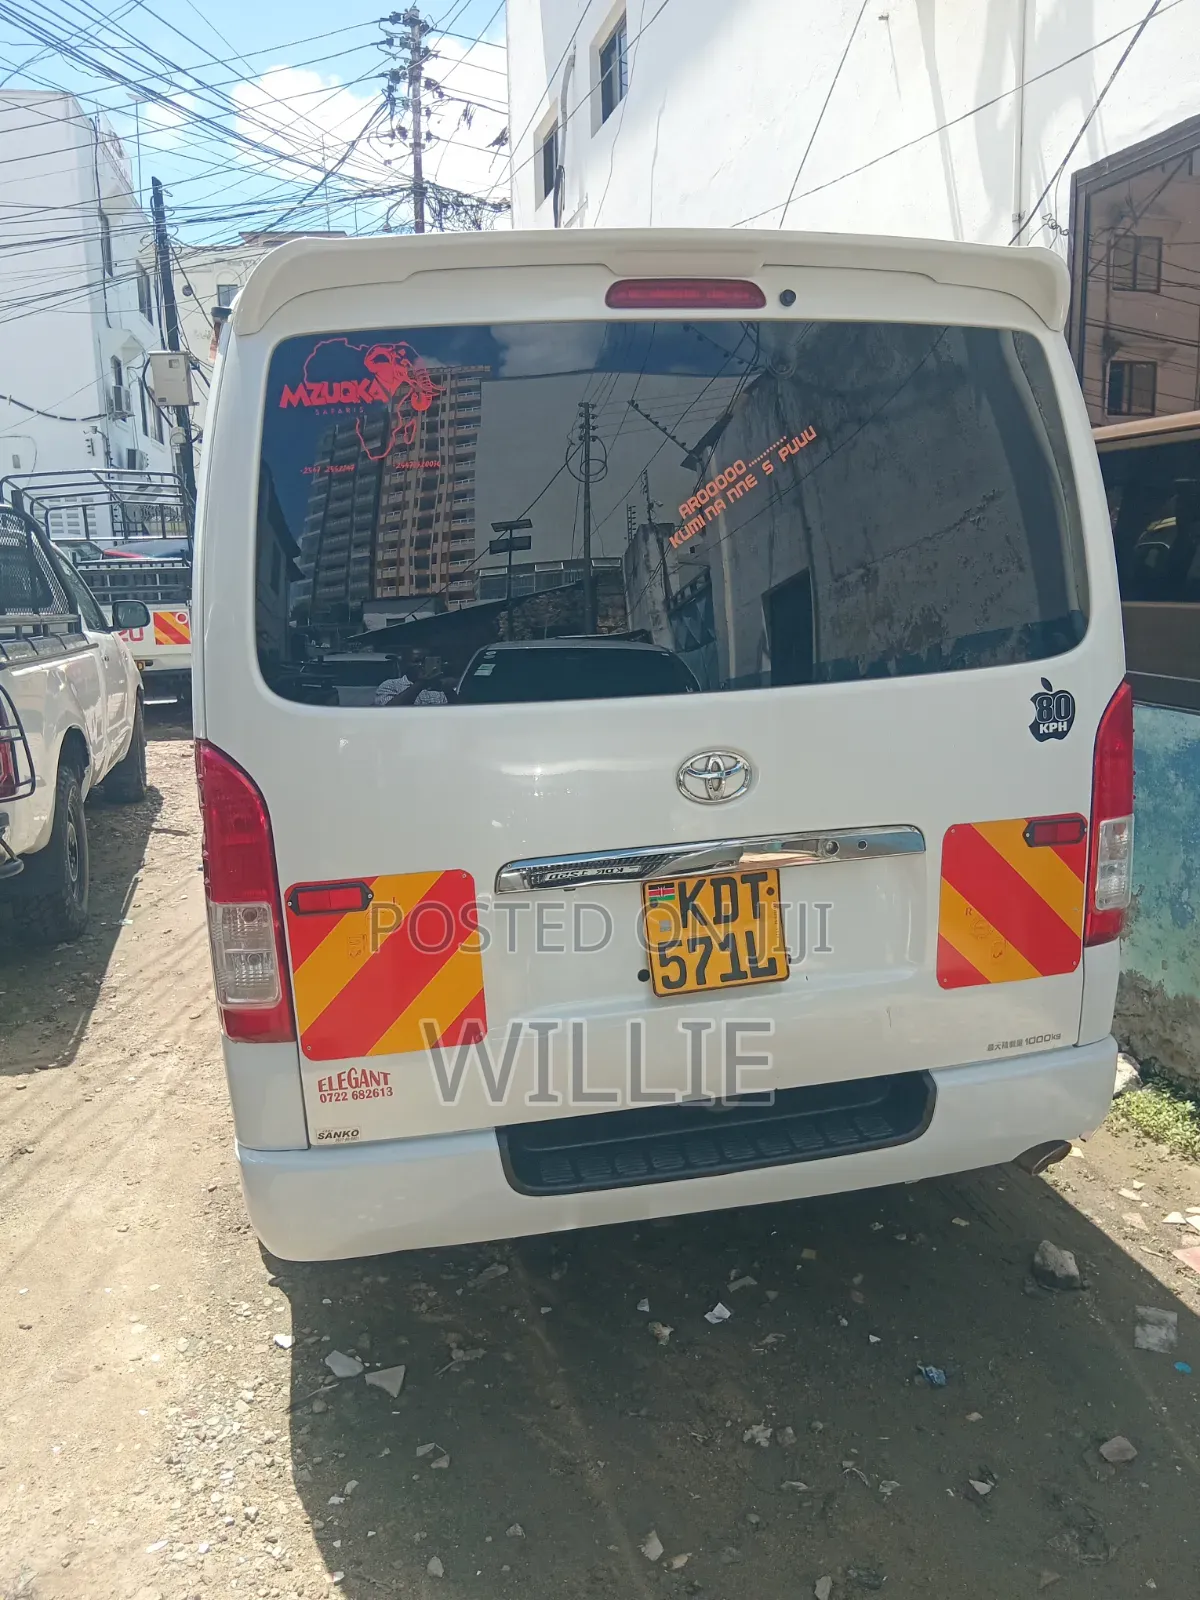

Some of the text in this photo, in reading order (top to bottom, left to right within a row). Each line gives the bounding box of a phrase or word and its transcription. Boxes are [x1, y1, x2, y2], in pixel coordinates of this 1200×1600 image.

[761, 459, 774, 475] S
[1035, 693, 1072, 723] 80
[1039, 721, 1068, 734] KPH
[677, 871, 768, 929] KDT
[657, 930, 778, 990] 571L
[318, 1067, 390, 1092] ELEGANT
[320, 1087, 393, 1103] 0722 682613
[317, 1129, 360, 1140] SANKO
